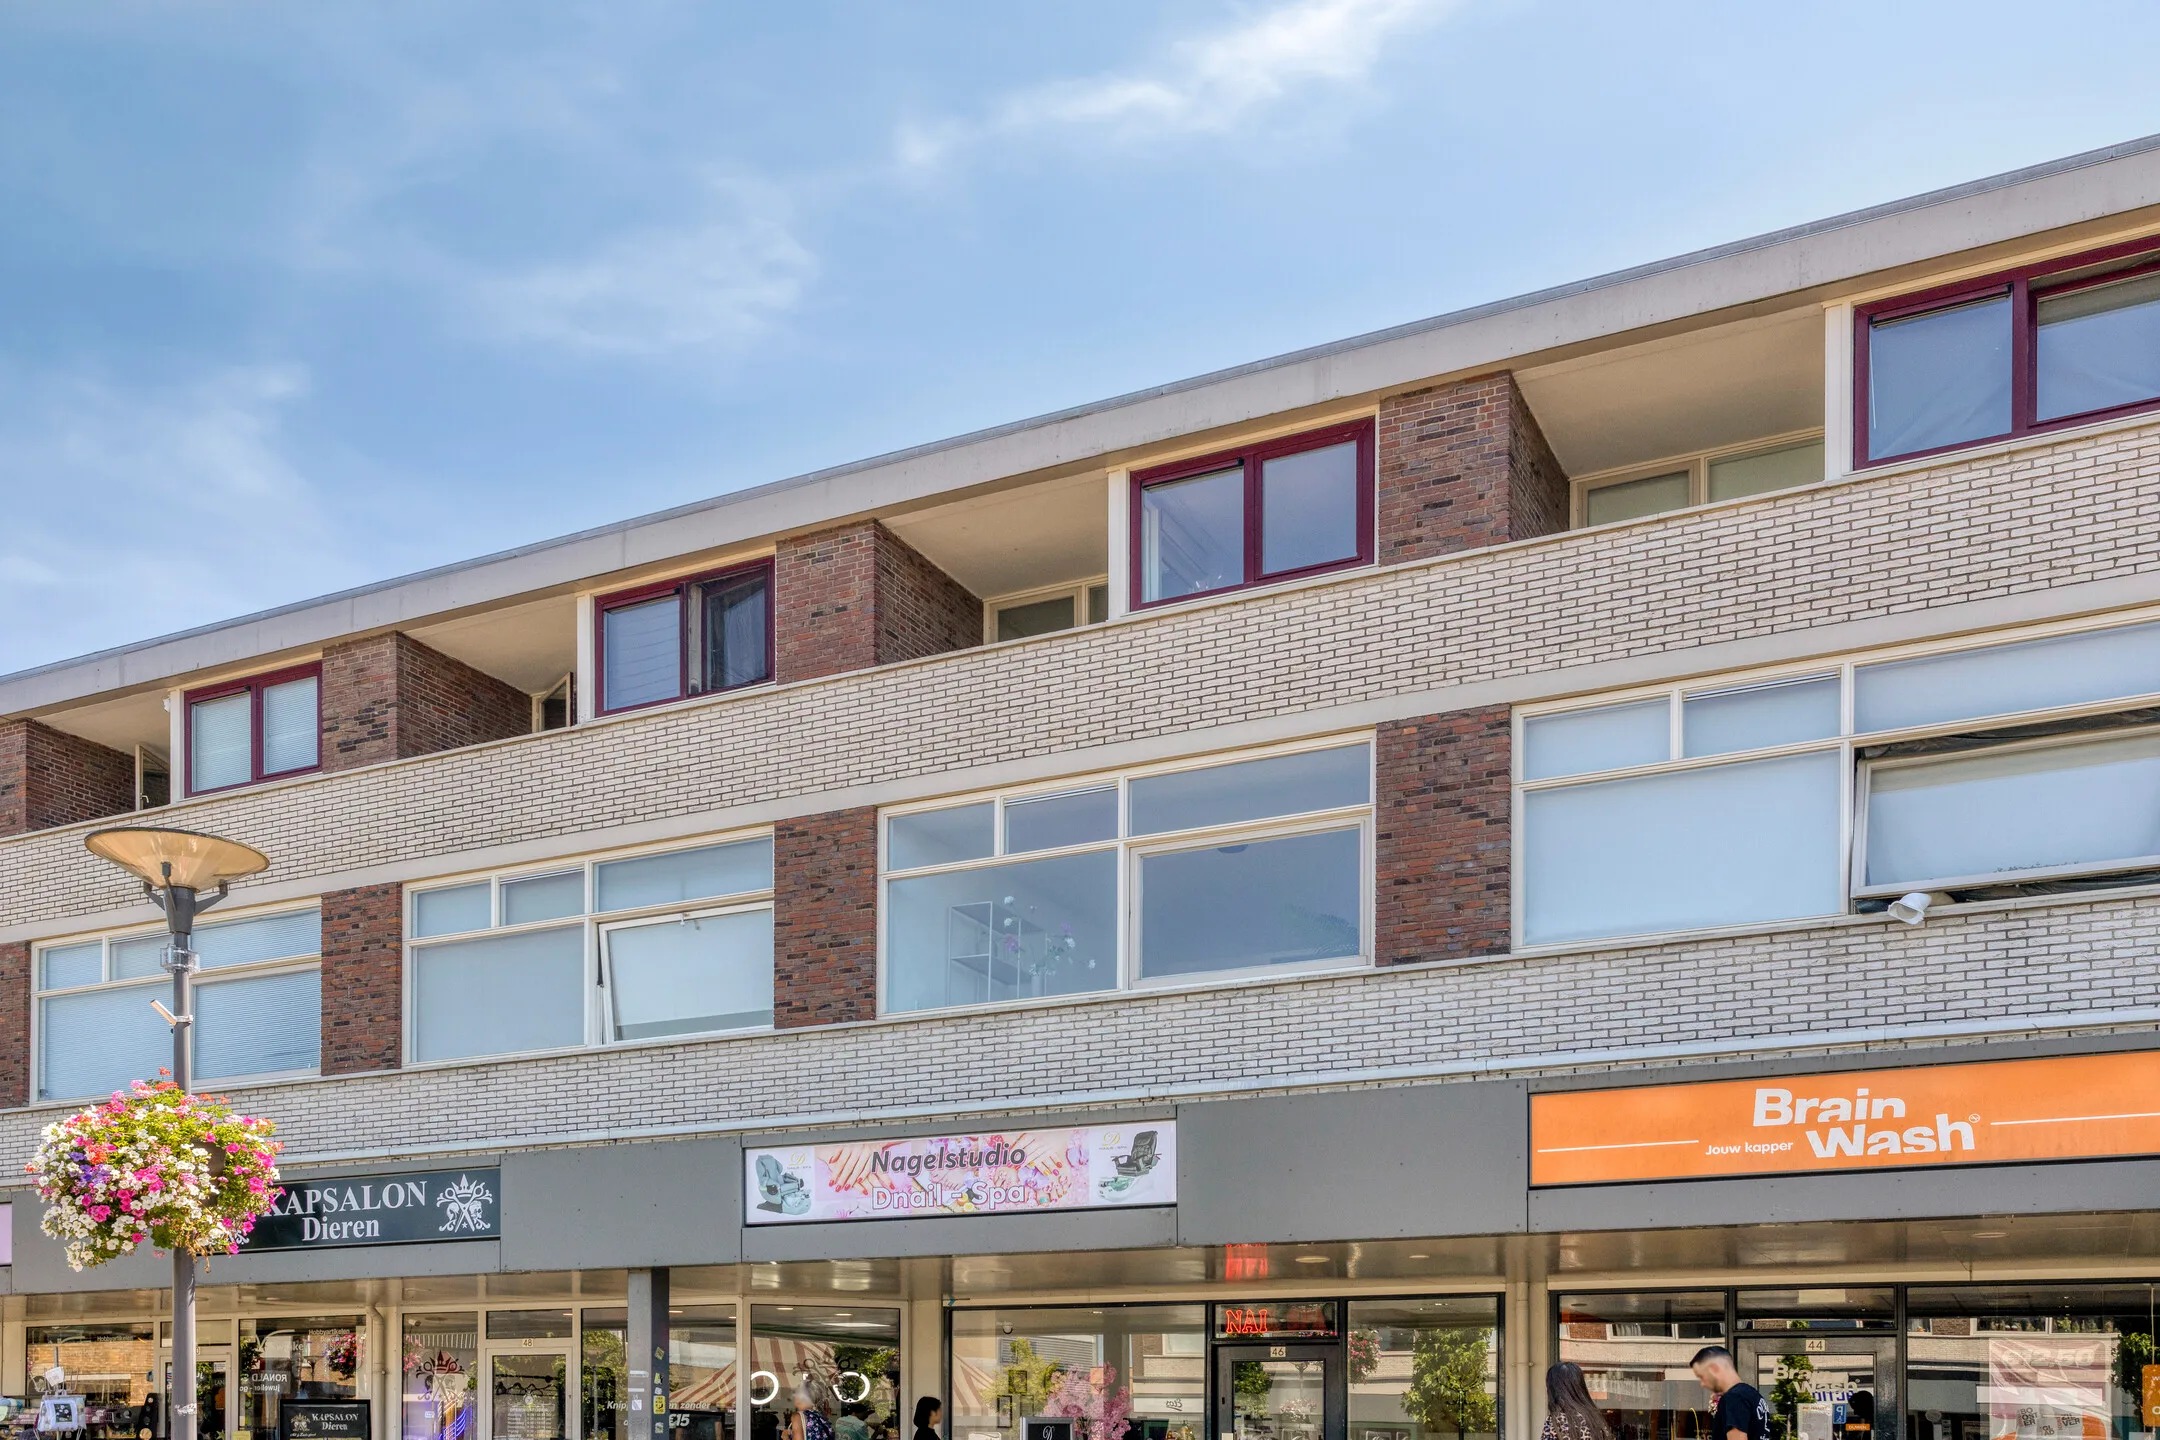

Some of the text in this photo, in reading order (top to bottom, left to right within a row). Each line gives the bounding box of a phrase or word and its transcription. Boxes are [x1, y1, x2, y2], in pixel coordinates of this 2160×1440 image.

[1753, 1088, 1906, 1127] Brain
[1705, 1141, 1794, 1156] Jouw kapper
[871, 1142, 1026, 1178] Nagelstudio
[262, 1181, 428, 1217] KAPSALON
[872, 1185, 944, 1211] Dnail
[973, 1181, 1027, 1211] Spa
[302, 1216, 381, 1242] Dieren
[523, 1339, 533, 1347] 48
[1807, 1340, 1824, 1350] 44
[1271, 1348, 1284, 1356] 46
[680, 1400, 711, 1410] zonder
[311, 1413, 359, 1422] KAPSALON
[321, 1421, 348, 1431] Dieren
